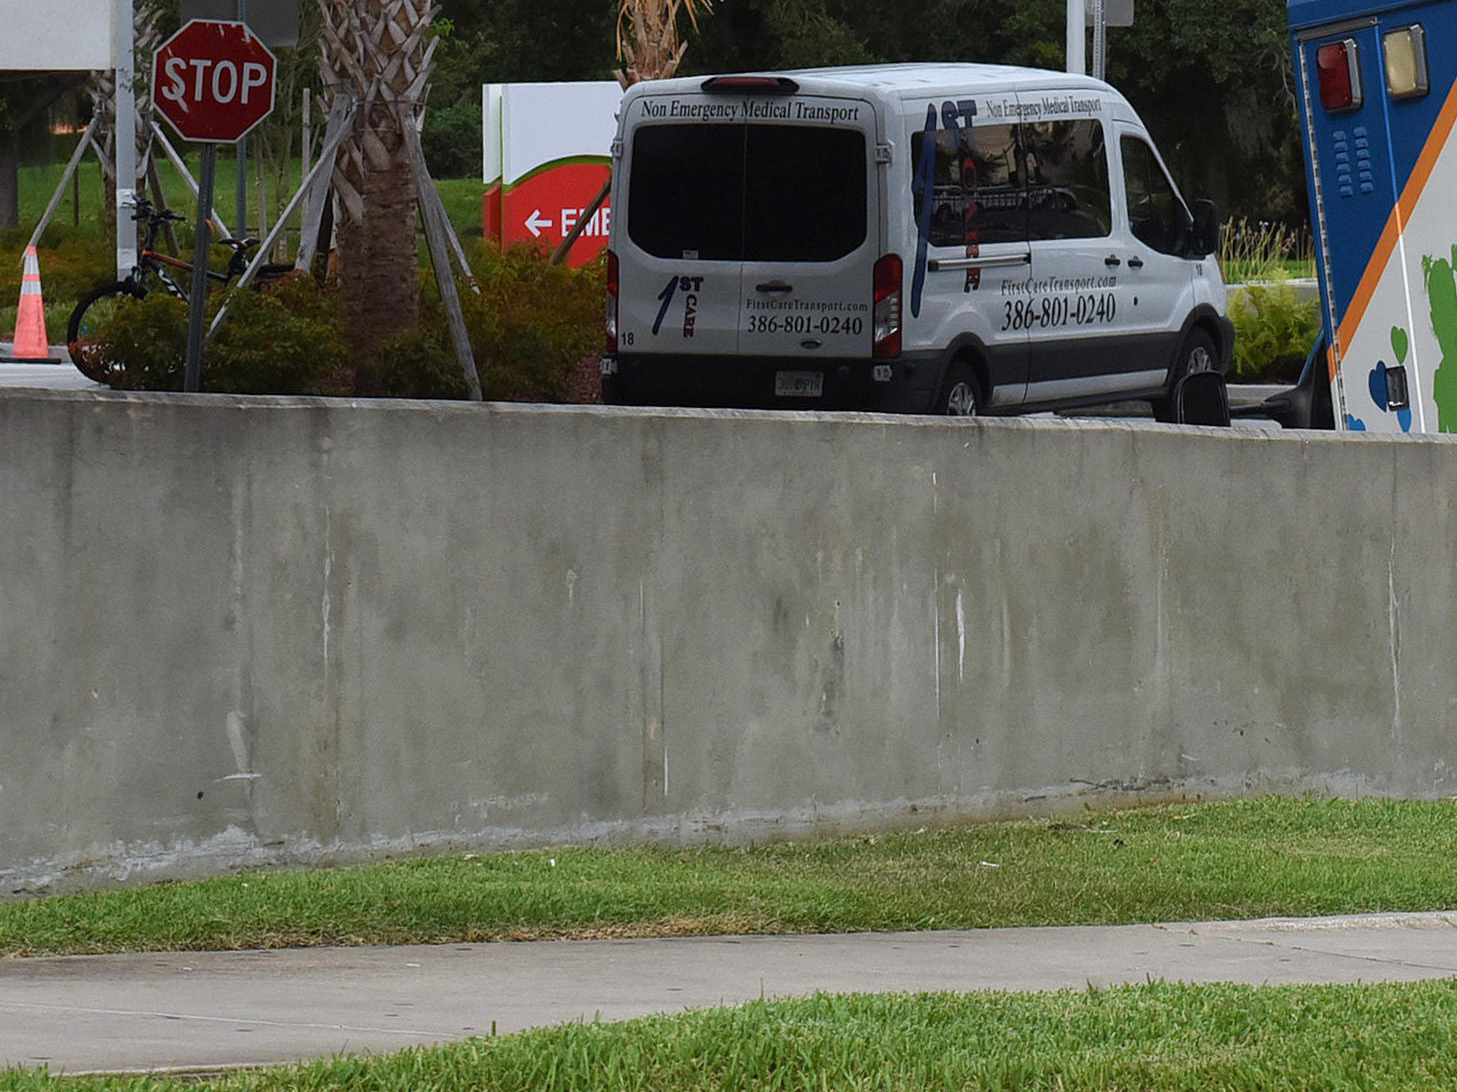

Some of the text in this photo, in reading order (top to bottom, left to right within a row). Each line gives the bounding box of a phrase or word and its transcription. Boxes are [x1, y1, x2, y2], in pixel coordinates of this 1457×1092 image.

[162, 57, 266, 106] STOP
[641, 101, 859, 124] Non Emergency Medical Transport
[986, 95, 1102, 120] Non Emergency Medical Transport
[683, 294, 698, 338] CARE
[747, 299, 868, 313] FirstCareTransport.com
[1001, 293, 1116, 331] 386-801-0240
[748, 315, 863, 335] 386-801-0240
[621, 333, 634, 346] 18
